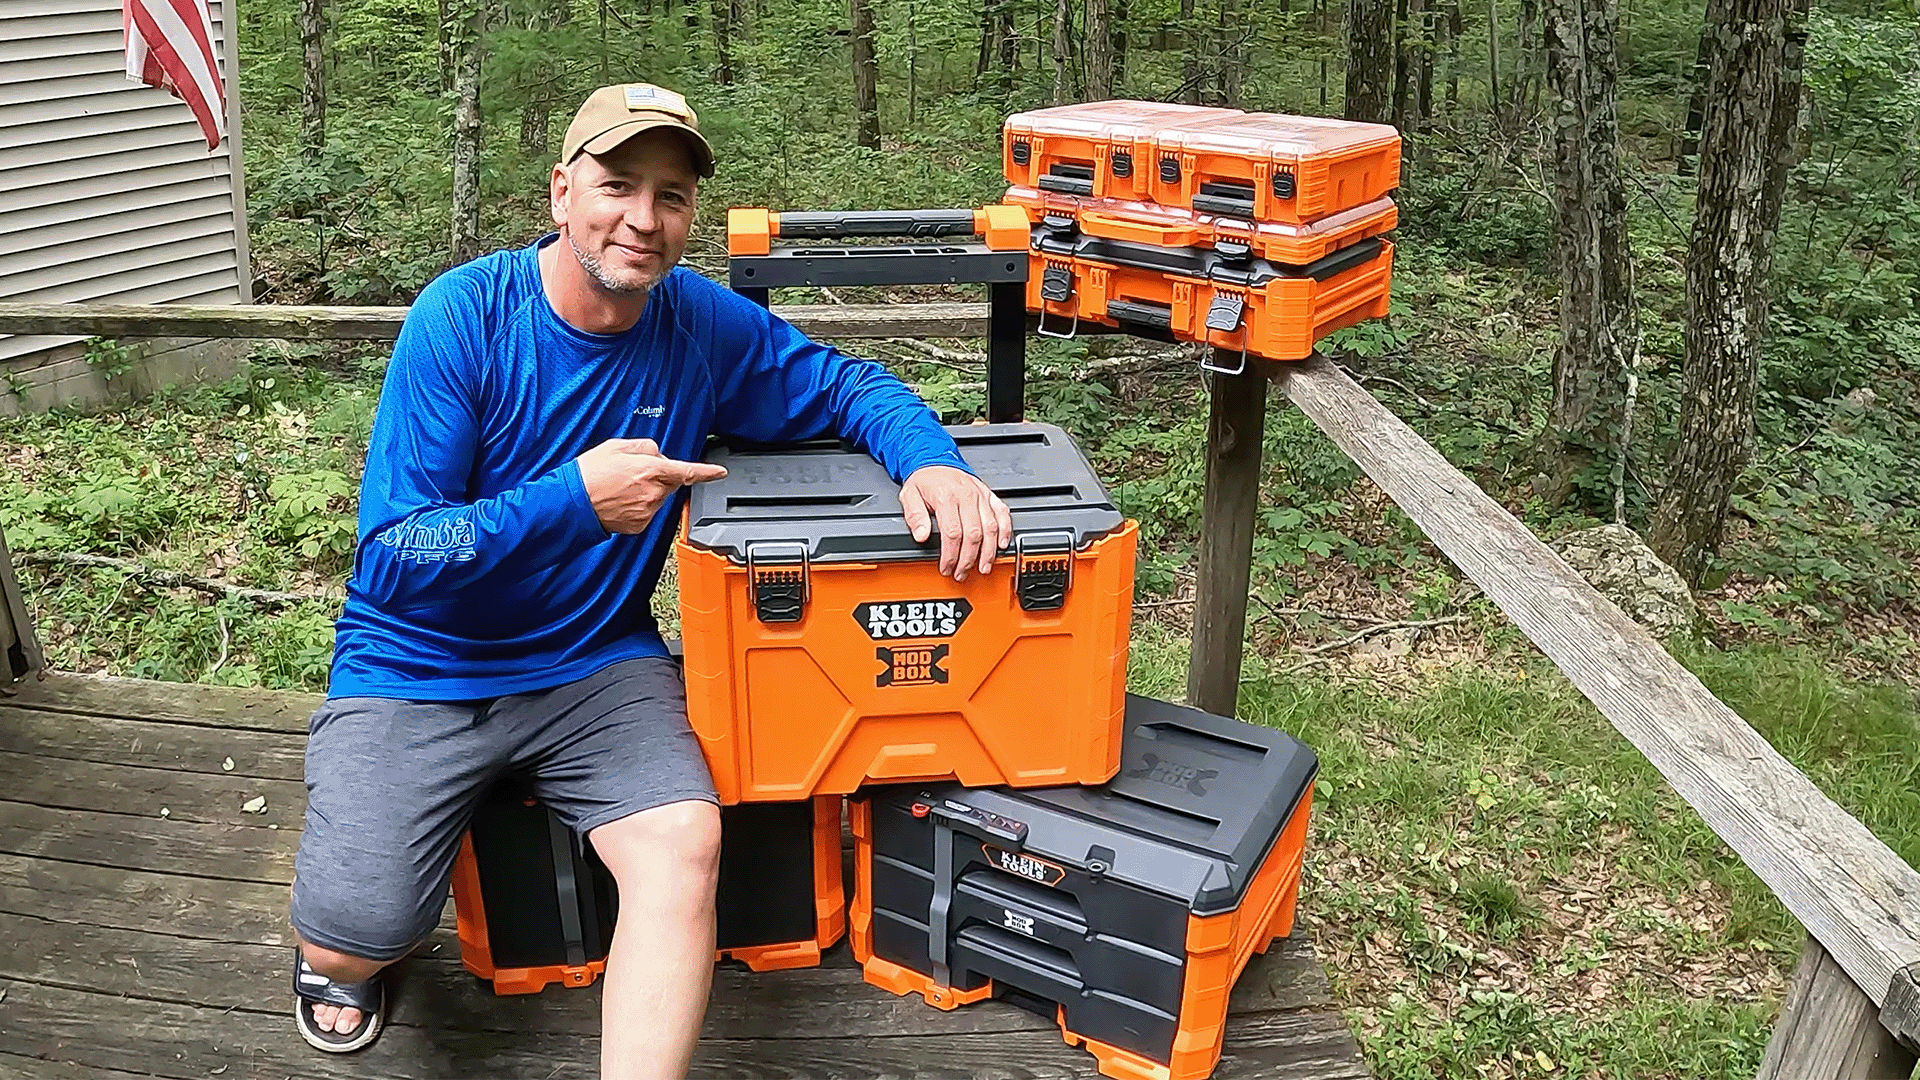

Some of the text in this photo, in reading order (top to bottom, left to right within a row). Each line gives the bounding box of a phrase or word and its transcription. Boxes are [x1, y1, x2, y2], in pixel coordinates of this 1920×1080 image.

[868, 602, 956, 622] KLEIN
[868, 618, 957, 638] TOOLS
[893, 651, 932, 666] MOD
[893, 665, 932, 680] BOX
[1001, 851, 1045, 873] KLEIN
[1001, 859, 1045, 881] TOOLS
